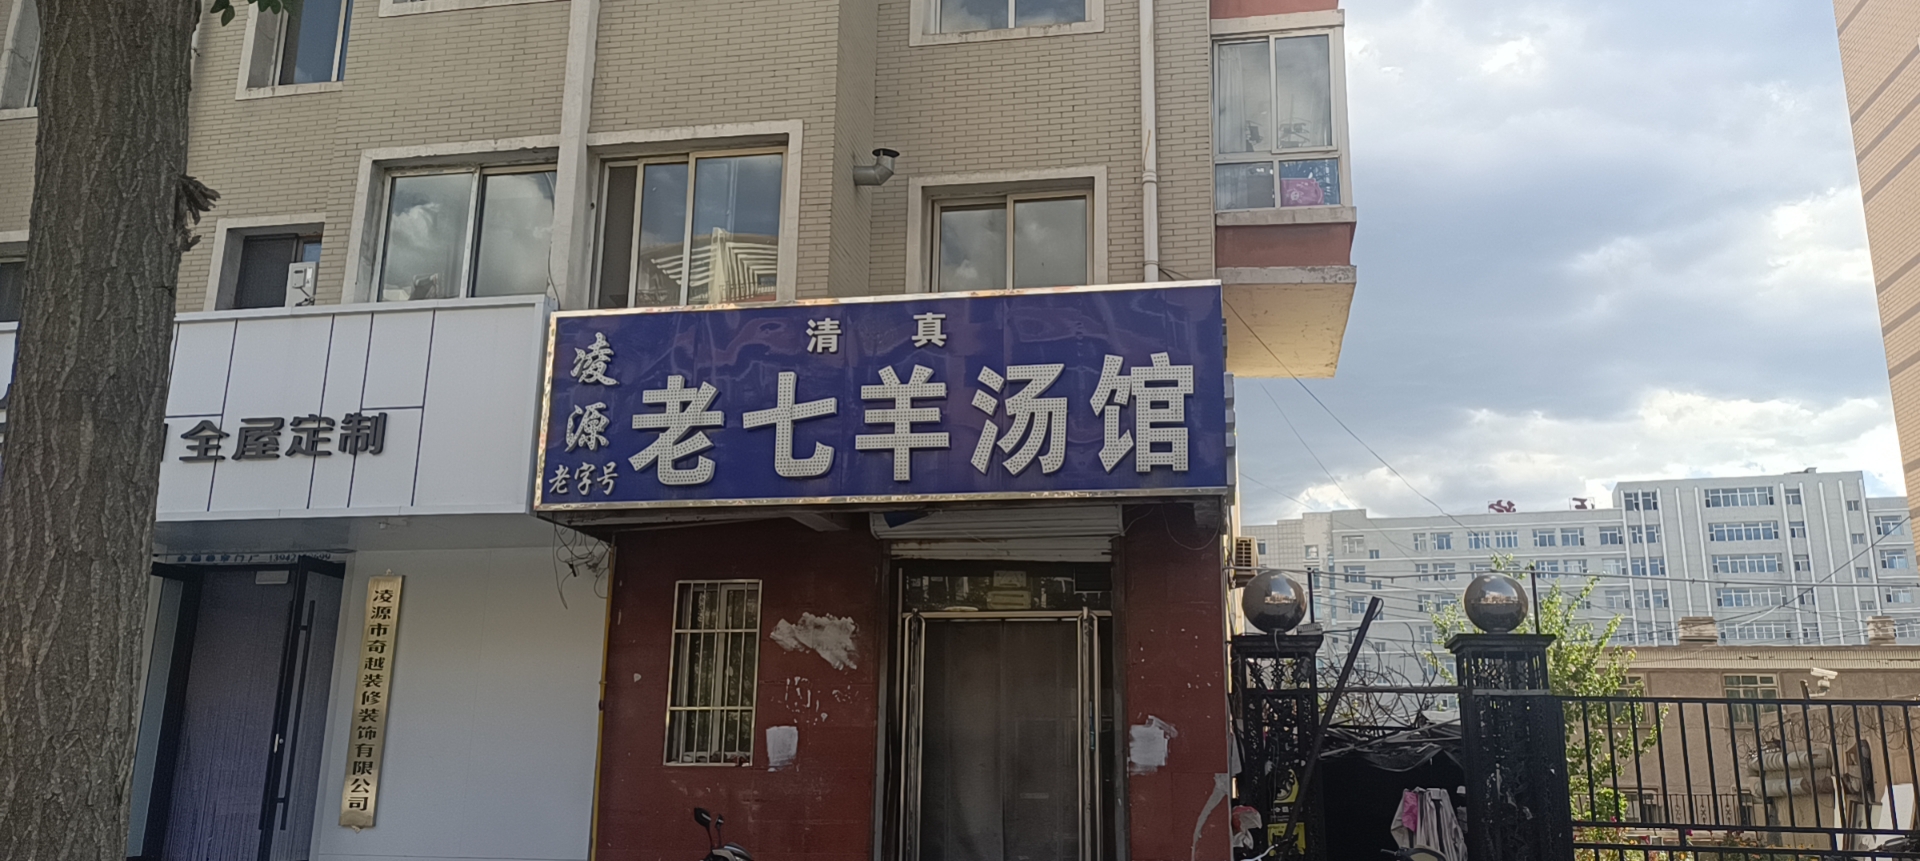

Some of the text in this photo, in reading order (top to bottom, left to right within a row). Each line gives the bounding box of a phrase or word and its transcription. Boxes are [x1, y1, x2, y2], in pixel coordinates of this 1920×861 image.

[806, 312, 947, 353] 清真
[565, 332, 620, 452] 凌源
[629, 352, 1194, 486] 老七羊汤馆
[179, 412, 387, 462] 全屋定制
[549, 461, 619, 496] 老字号
[348, 588, 395, 812] 凌源市奇越装修装饰有限公司
